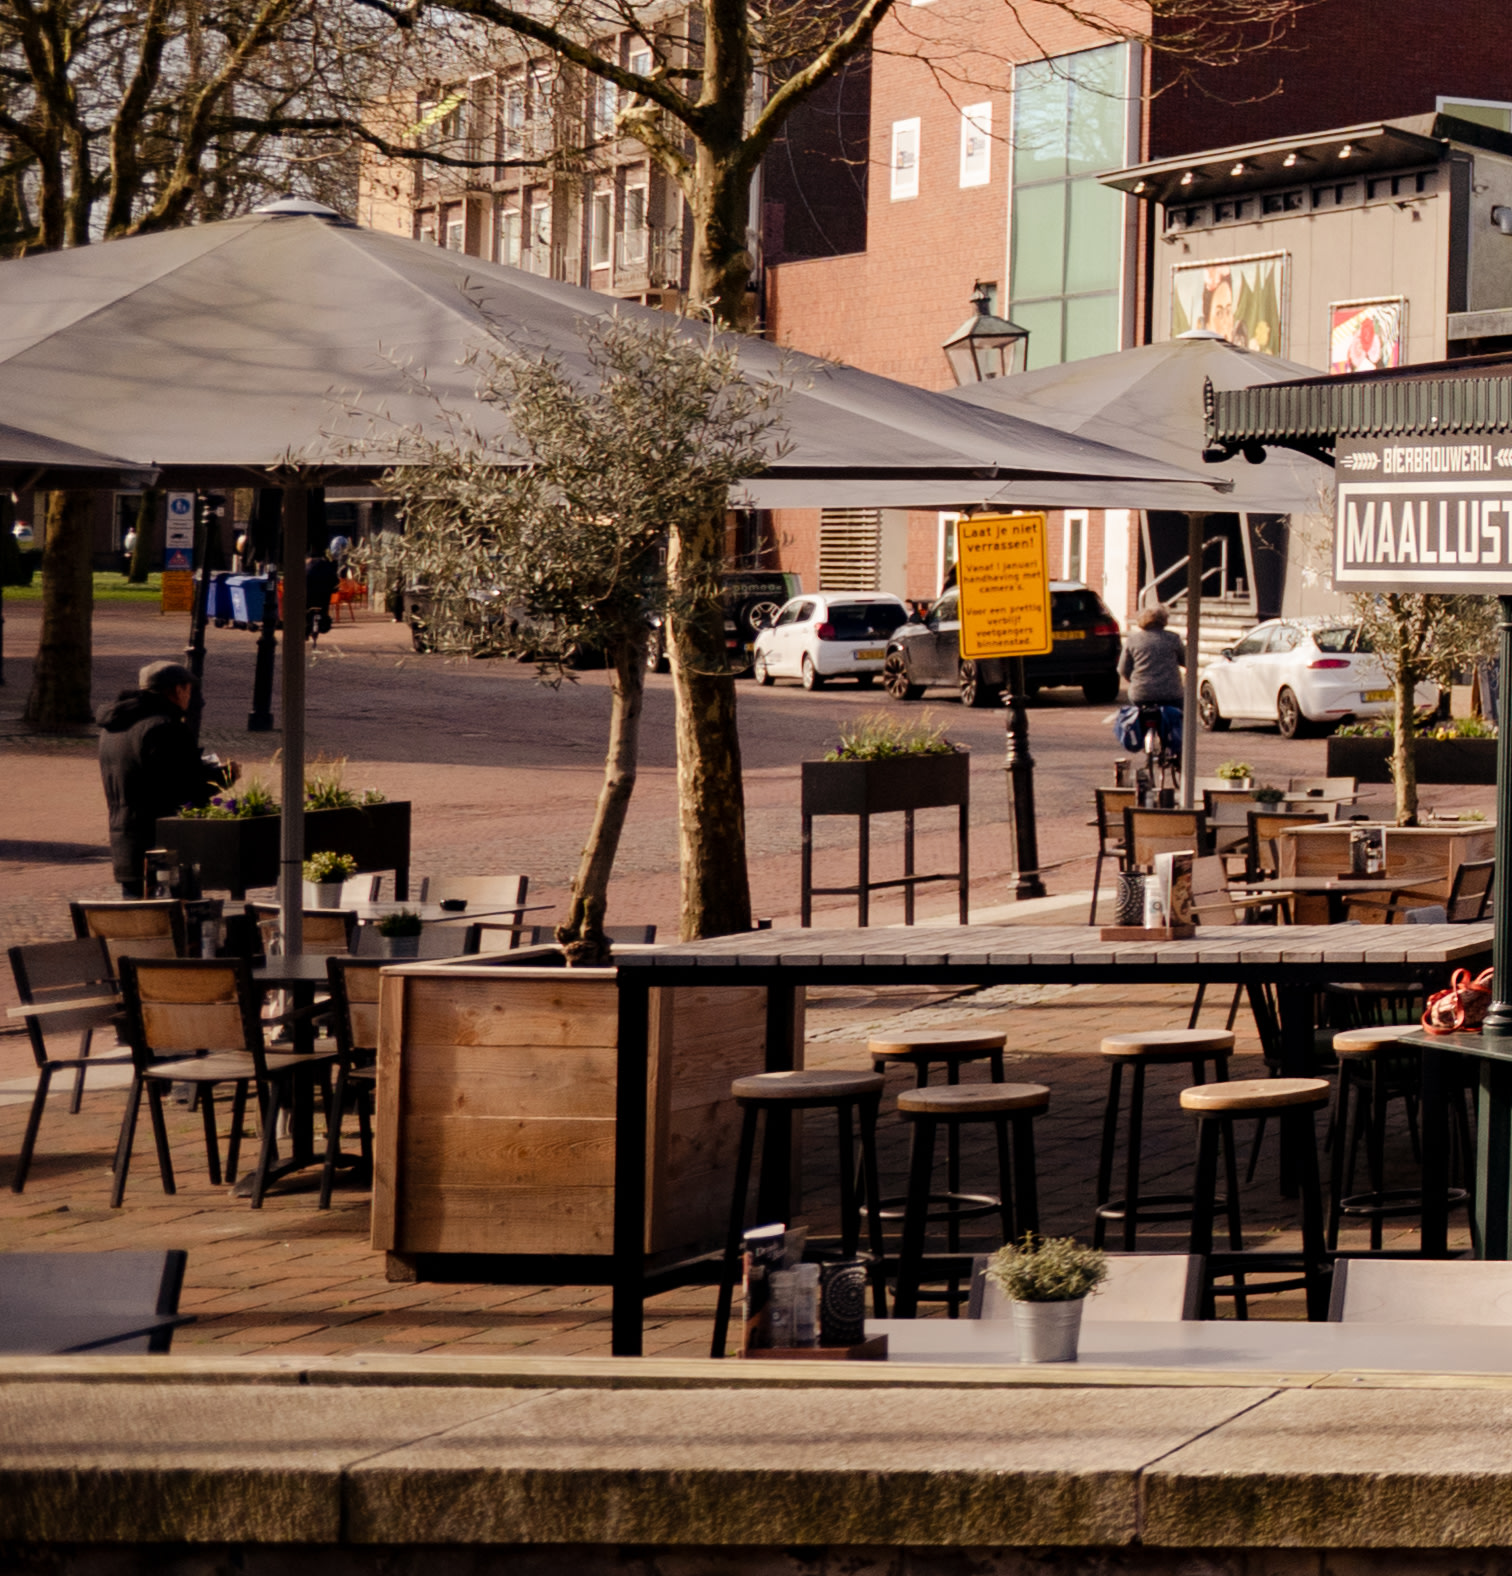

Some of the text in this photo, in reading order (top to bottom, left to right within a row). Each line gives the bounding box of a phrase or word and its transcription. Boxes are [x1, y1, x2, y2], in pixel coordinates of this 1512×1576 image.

[1383, 444, 1492, 474] BIERBROUWERIJ
[963, 524, 1037, 539] Laat je niet
[967, 538, 1034, 552] verrassen!
